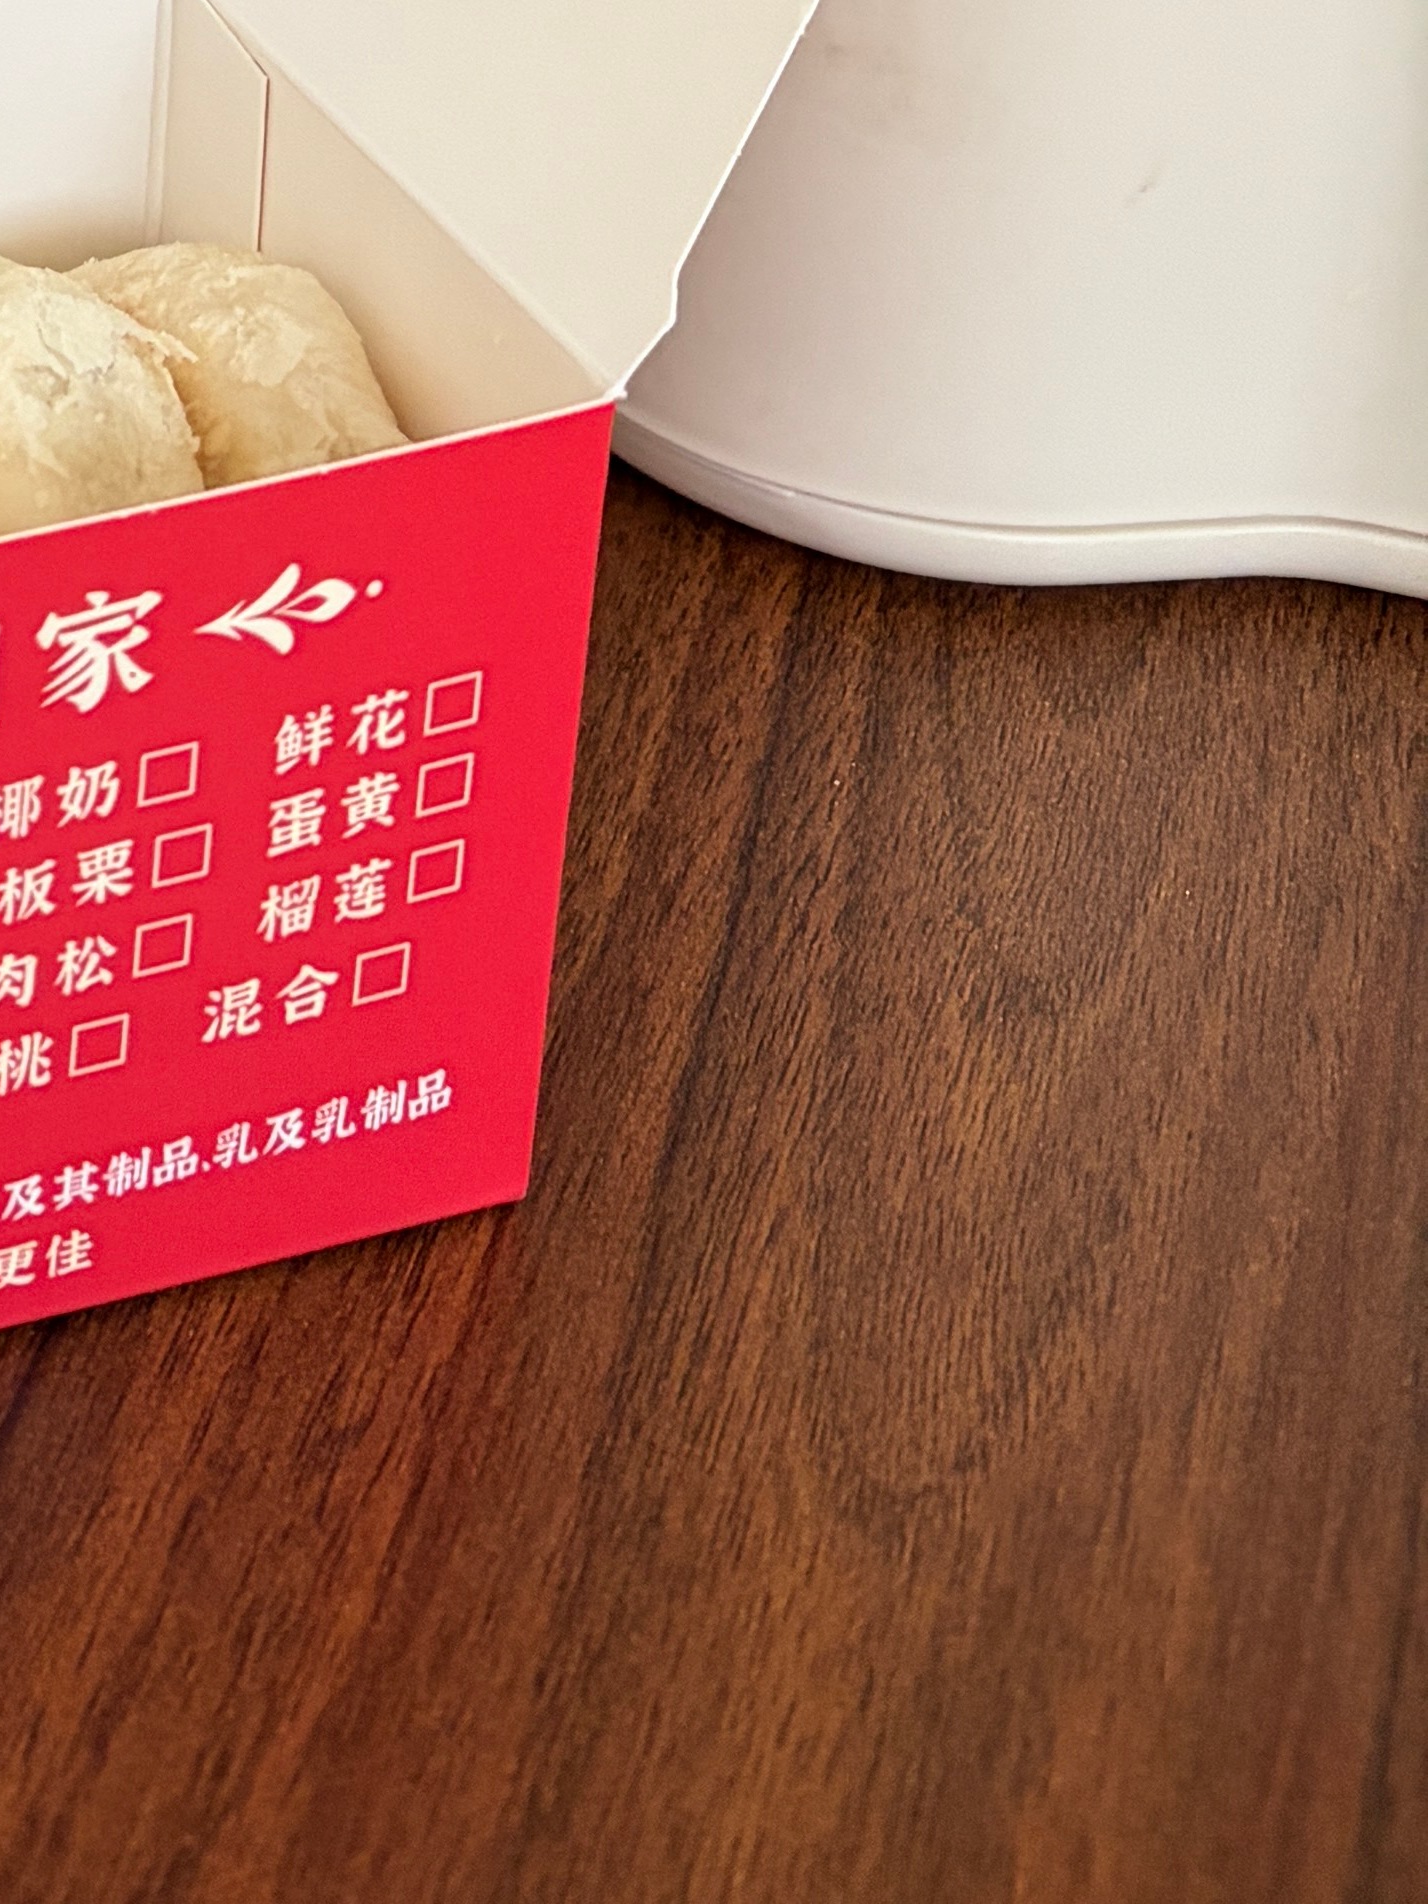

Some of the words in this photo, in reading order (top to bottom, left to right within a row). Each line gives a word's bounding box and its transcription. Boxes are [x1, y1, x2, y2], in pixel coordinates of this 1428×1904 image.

[275, 689, 408, 774] 鲜花
[267, 772, 399, 857] 蛋黄
[257, 858, 392, 941] 榴莲
[202, 967, 338, 1042] 混合
